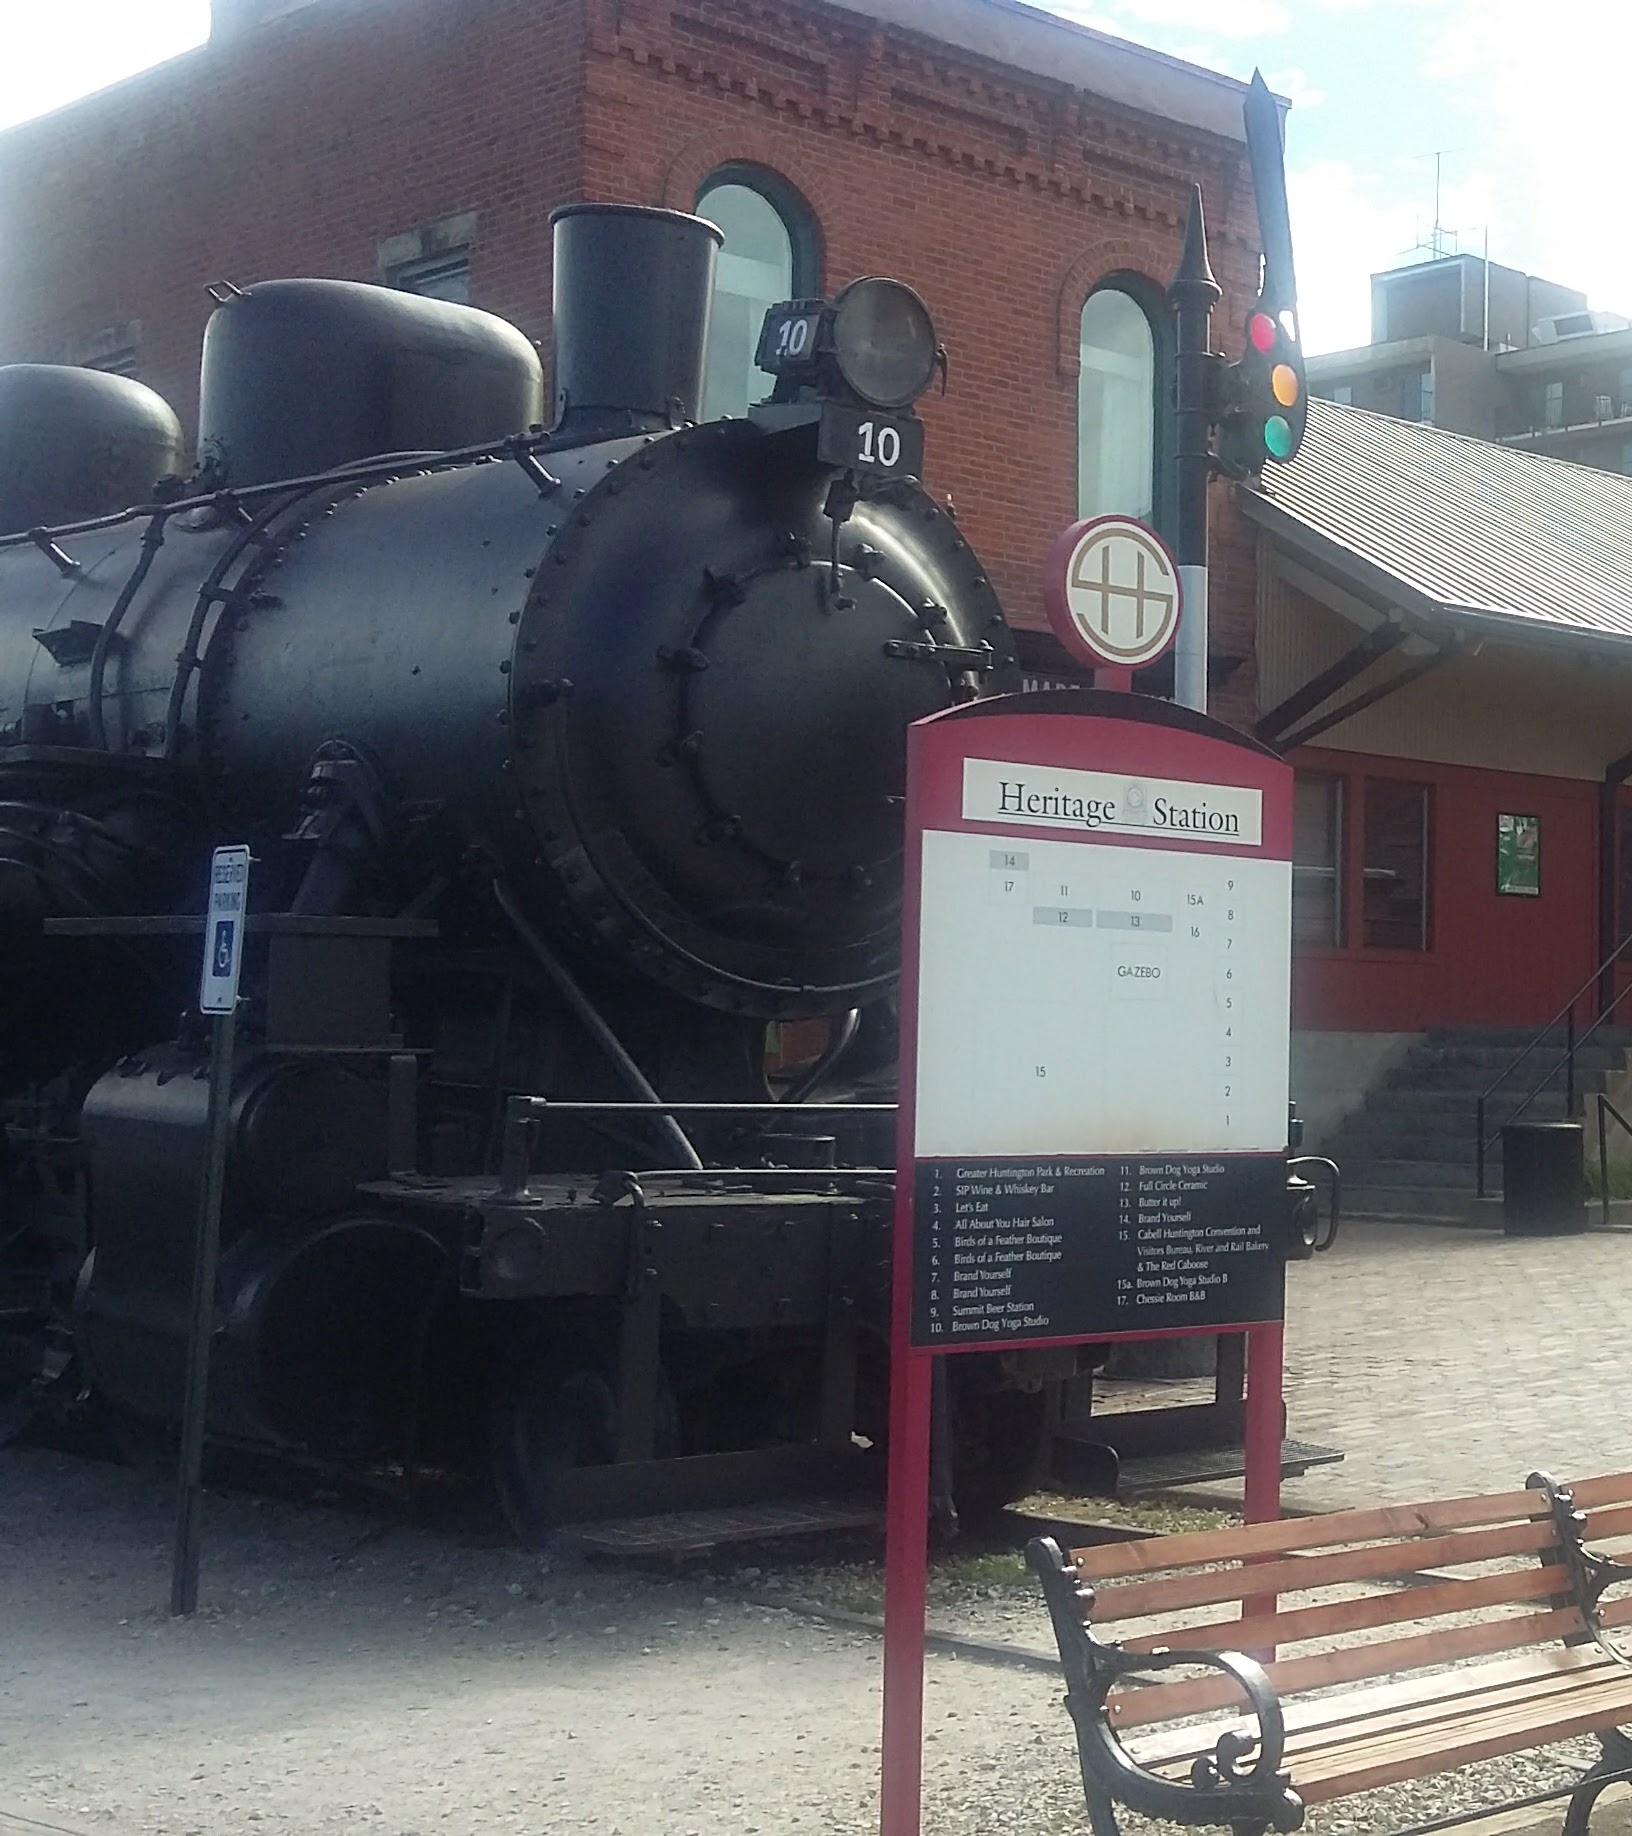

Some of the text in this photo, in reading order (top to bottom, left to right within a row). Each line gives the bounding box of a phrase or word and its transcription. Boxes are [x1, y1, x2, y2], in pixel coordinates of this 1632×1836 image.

[775, 319, 808, 357] 10
[858, 422, 900, 467] 10
[999, 781, 1239, 834] Heritage Station
[1004, 854, 1016, 867] 14
[1004, 881, 1015, 892] 17
[1061, 886, 1068, 897] 11
[1228, 881, 1234, 891] 9
[1131, 891, 1141, 901] 10
[1187, 894, 1204, 906] 15A
[1058, 912, 1068, 922] 12
[1228, 910, 1234, 921] 8
[1131, 917, 1141, 927] 13
[1190, 927, 1200, 938] 16
[1227, 940, 1232, 950] 7
[1117, 966, 1161, 978] GAZEBO
[1226, 969, 1232, 979] 6
[1226, 998, 1232, 1009] 5
[1226, 1027, 1232, 1037] 4
[1226, 1057, 1231, 1067] 3
[1036, 1067, 1046, 1078] 15
[1225, 1086, 1231, 1097] 2
[935, 1167, 1105, 1180] 1. Greater Huntington Park & Recreation
[1121, 1164, 1225, 1177] 11. Brown Dog Yoga Studio
[933, 1184, 1055, 1197] 2. SIP Wine & Whiskey Bar
[1121, 1181, 1208, 1191] 12. Full Circle Ceramic
[933, 1202, 989, 1213] 3. Let's Eat
[1121, 1199, 1131, 1208] 13.
[1163, 1198, 1167, 1207] it
[1169, 1197, 1181, 1209] up!
[932, 1216, 1054, 1231] 4. All About You Hair Salon
[1120, 1211, 1191, 1224] 14. Brand Yourself
[1119, 1225, 1261, 1240] 15. Cabell Huntington Convention and
[933, 1238, 940, 1248] 5.
[955, 1236, 976, 1247] Birds
[978, 1236, 987, 1246] of
[996, 1235, 1025, 1245] Feather
[1027, 1234, 1062, 1246] Boutique
[1196, 1243, 1214, 1254] River
[1215, 1243, 1229, 1252] and
[1231, 1242, 1244, 1251] Rail
[1246, 1241, 1269, 1252] Bakery
[932, 1256, 940, 1266] 6.
[955, 1253, 975, 1264] Birds
[977, 1253, 987, 1263] of
[996, 1252, 1024, 1263] Feather
[1026, 1251, 1062, 1262] Boutique
[1138, 1259, 1209, 1272] & The Red Caboose
[932, 1268, 1012, 1283] 7. Brand Yourself
[1137, 1278, 1161, 1288] Brown
[1163, 1277, 1179, 1289] Dog
[1180, 1276, 1197, 1288] Yoga
[1198, 1274, 1221, 1284] Studio
[1223, 1274, 1228, 1283] B
[931, 1285, 1012, 1300] 8. Brand Yourself
[1117, 1296, 1128, 1306] 17.
[1167, 1292, 1188, 1302] Room
[1190, 1291, 1206, 1300] B&B
[931, 1302, 1034, 1318] 9. Summit Beer Station
[931, 1315, 1049, 1333] 10. Brown Dog Yoga Studio
